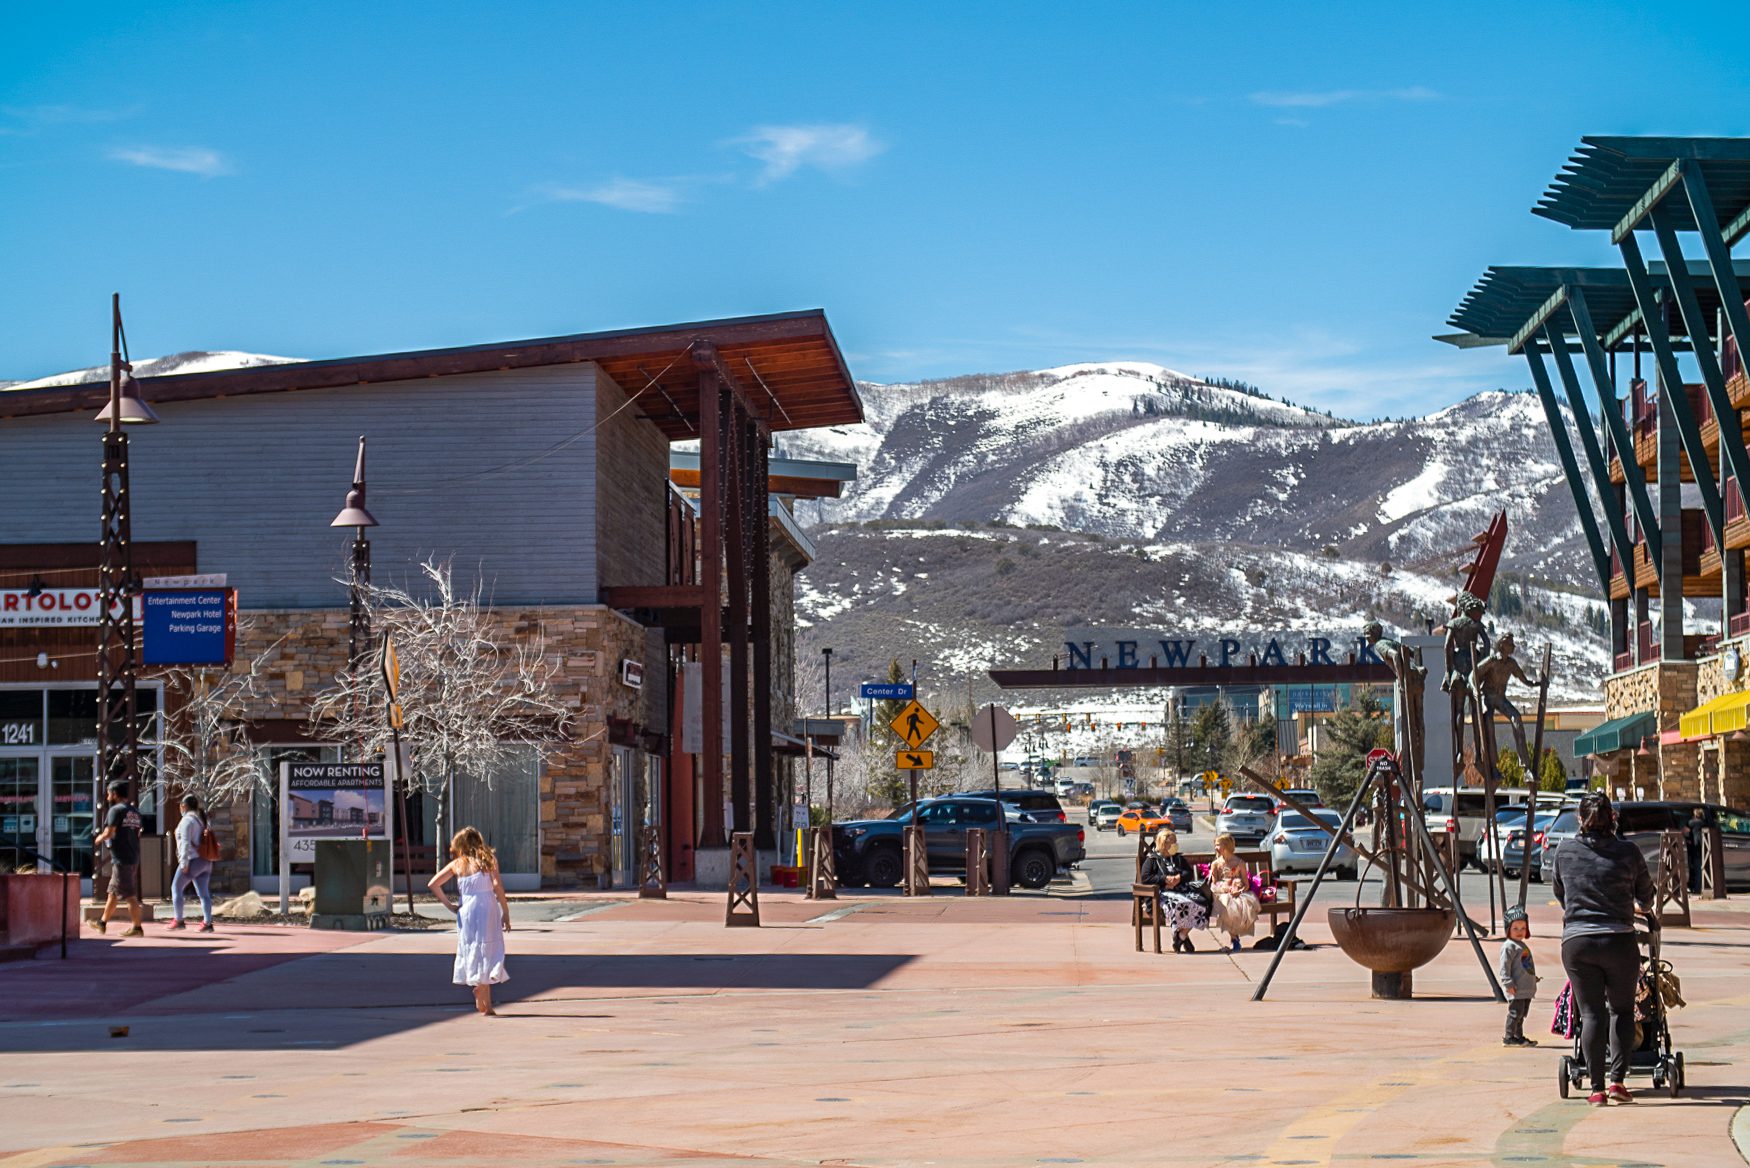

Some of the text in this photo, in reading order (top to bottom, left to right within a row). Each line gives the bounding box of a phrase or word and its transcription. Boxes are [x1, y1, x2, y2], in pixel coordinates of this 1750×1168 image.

[147, 596, 221, 606] Entertainment Center
[19, 616, 63, 624] INSPIRED
[67, 616, 101, 624] KITCHE
[171, 610, 222, 620] Newpark Hotel
[168, 624, 222, 634] Parking Garage
[1064, 637, 1386, 671] NEWPARK
[2, 722, 34, 744] 1241
[293, 766, 380, 777] NOW RENTING
[291, 779, 383, 787] AFFORDABLE APARTMENTS
